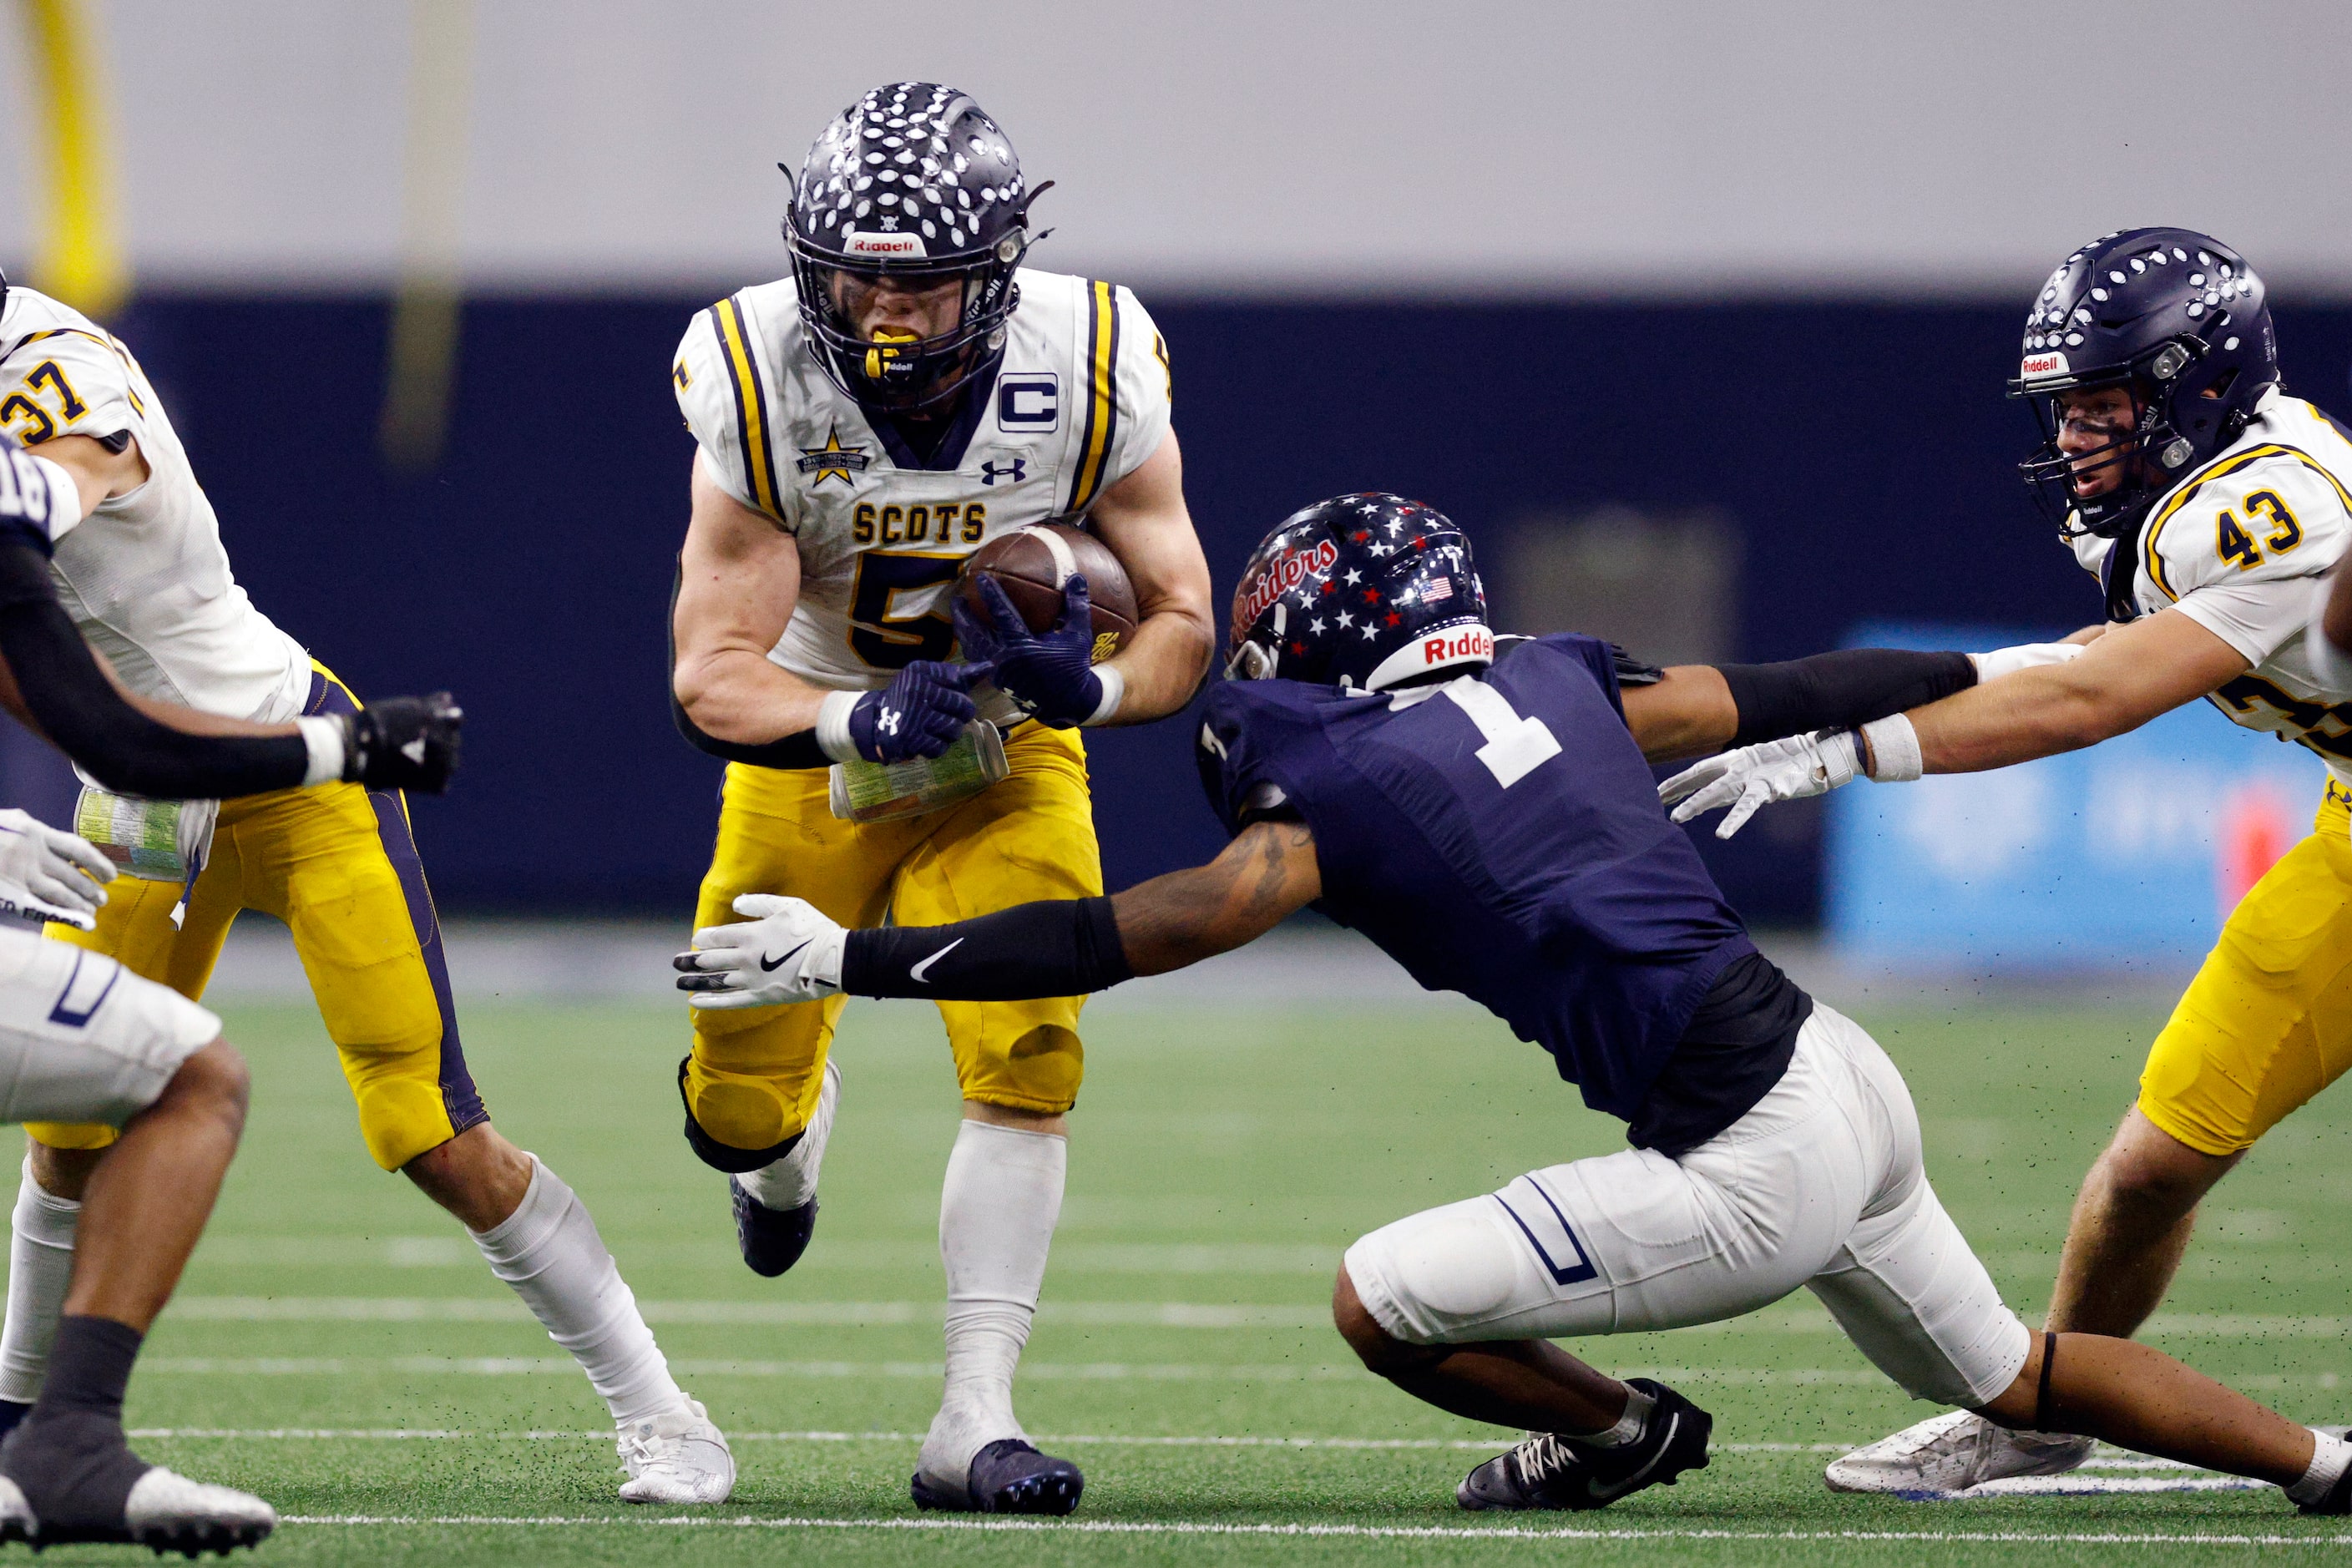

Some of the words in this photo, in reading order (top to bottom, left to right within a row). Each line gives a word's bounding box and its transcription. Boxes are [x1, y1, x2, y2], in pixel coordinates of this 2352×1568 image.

[0, 357, 91, 448] 37
[1001, 382, 1056, 422] C
[2023, 357, 2057, 372] Riddell
[852, 502, 987, 544] SCOTS
[2216, 488, 2304, 572] 43
[847, 549, 969, 670] 5
[1388, 674, 1563, 790] 1
